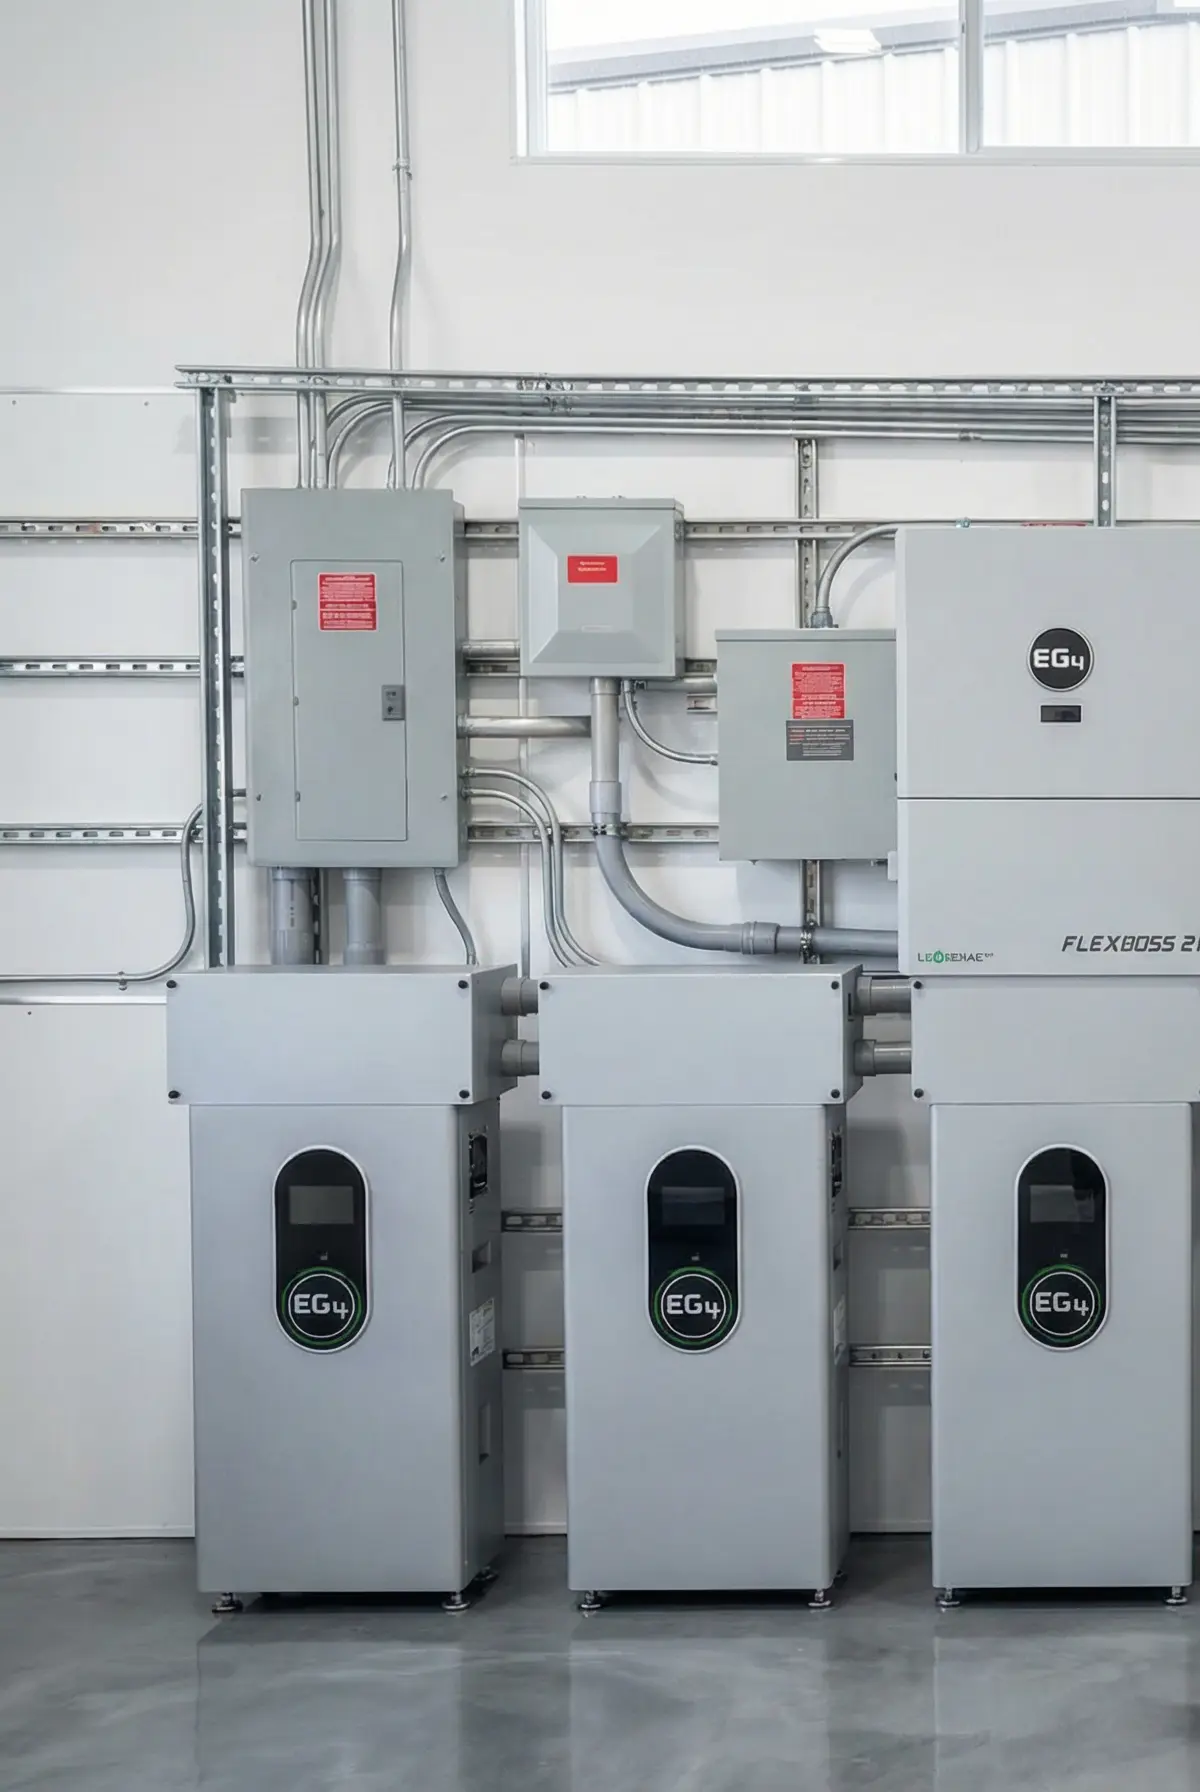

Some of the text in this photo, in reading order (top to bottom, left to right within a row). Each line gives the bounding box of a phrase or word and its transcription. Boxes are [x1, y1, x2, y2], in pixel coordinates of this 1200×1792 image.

[1033, 648, 1084, 671] EG4
[1061, 935, 1176, 952] FLEXBOSS
[294, 1293, 349, 1320] EG4
[666, 1294, 721, 1319] EG4
[1035, 1292, 1089, 1316] EG4
